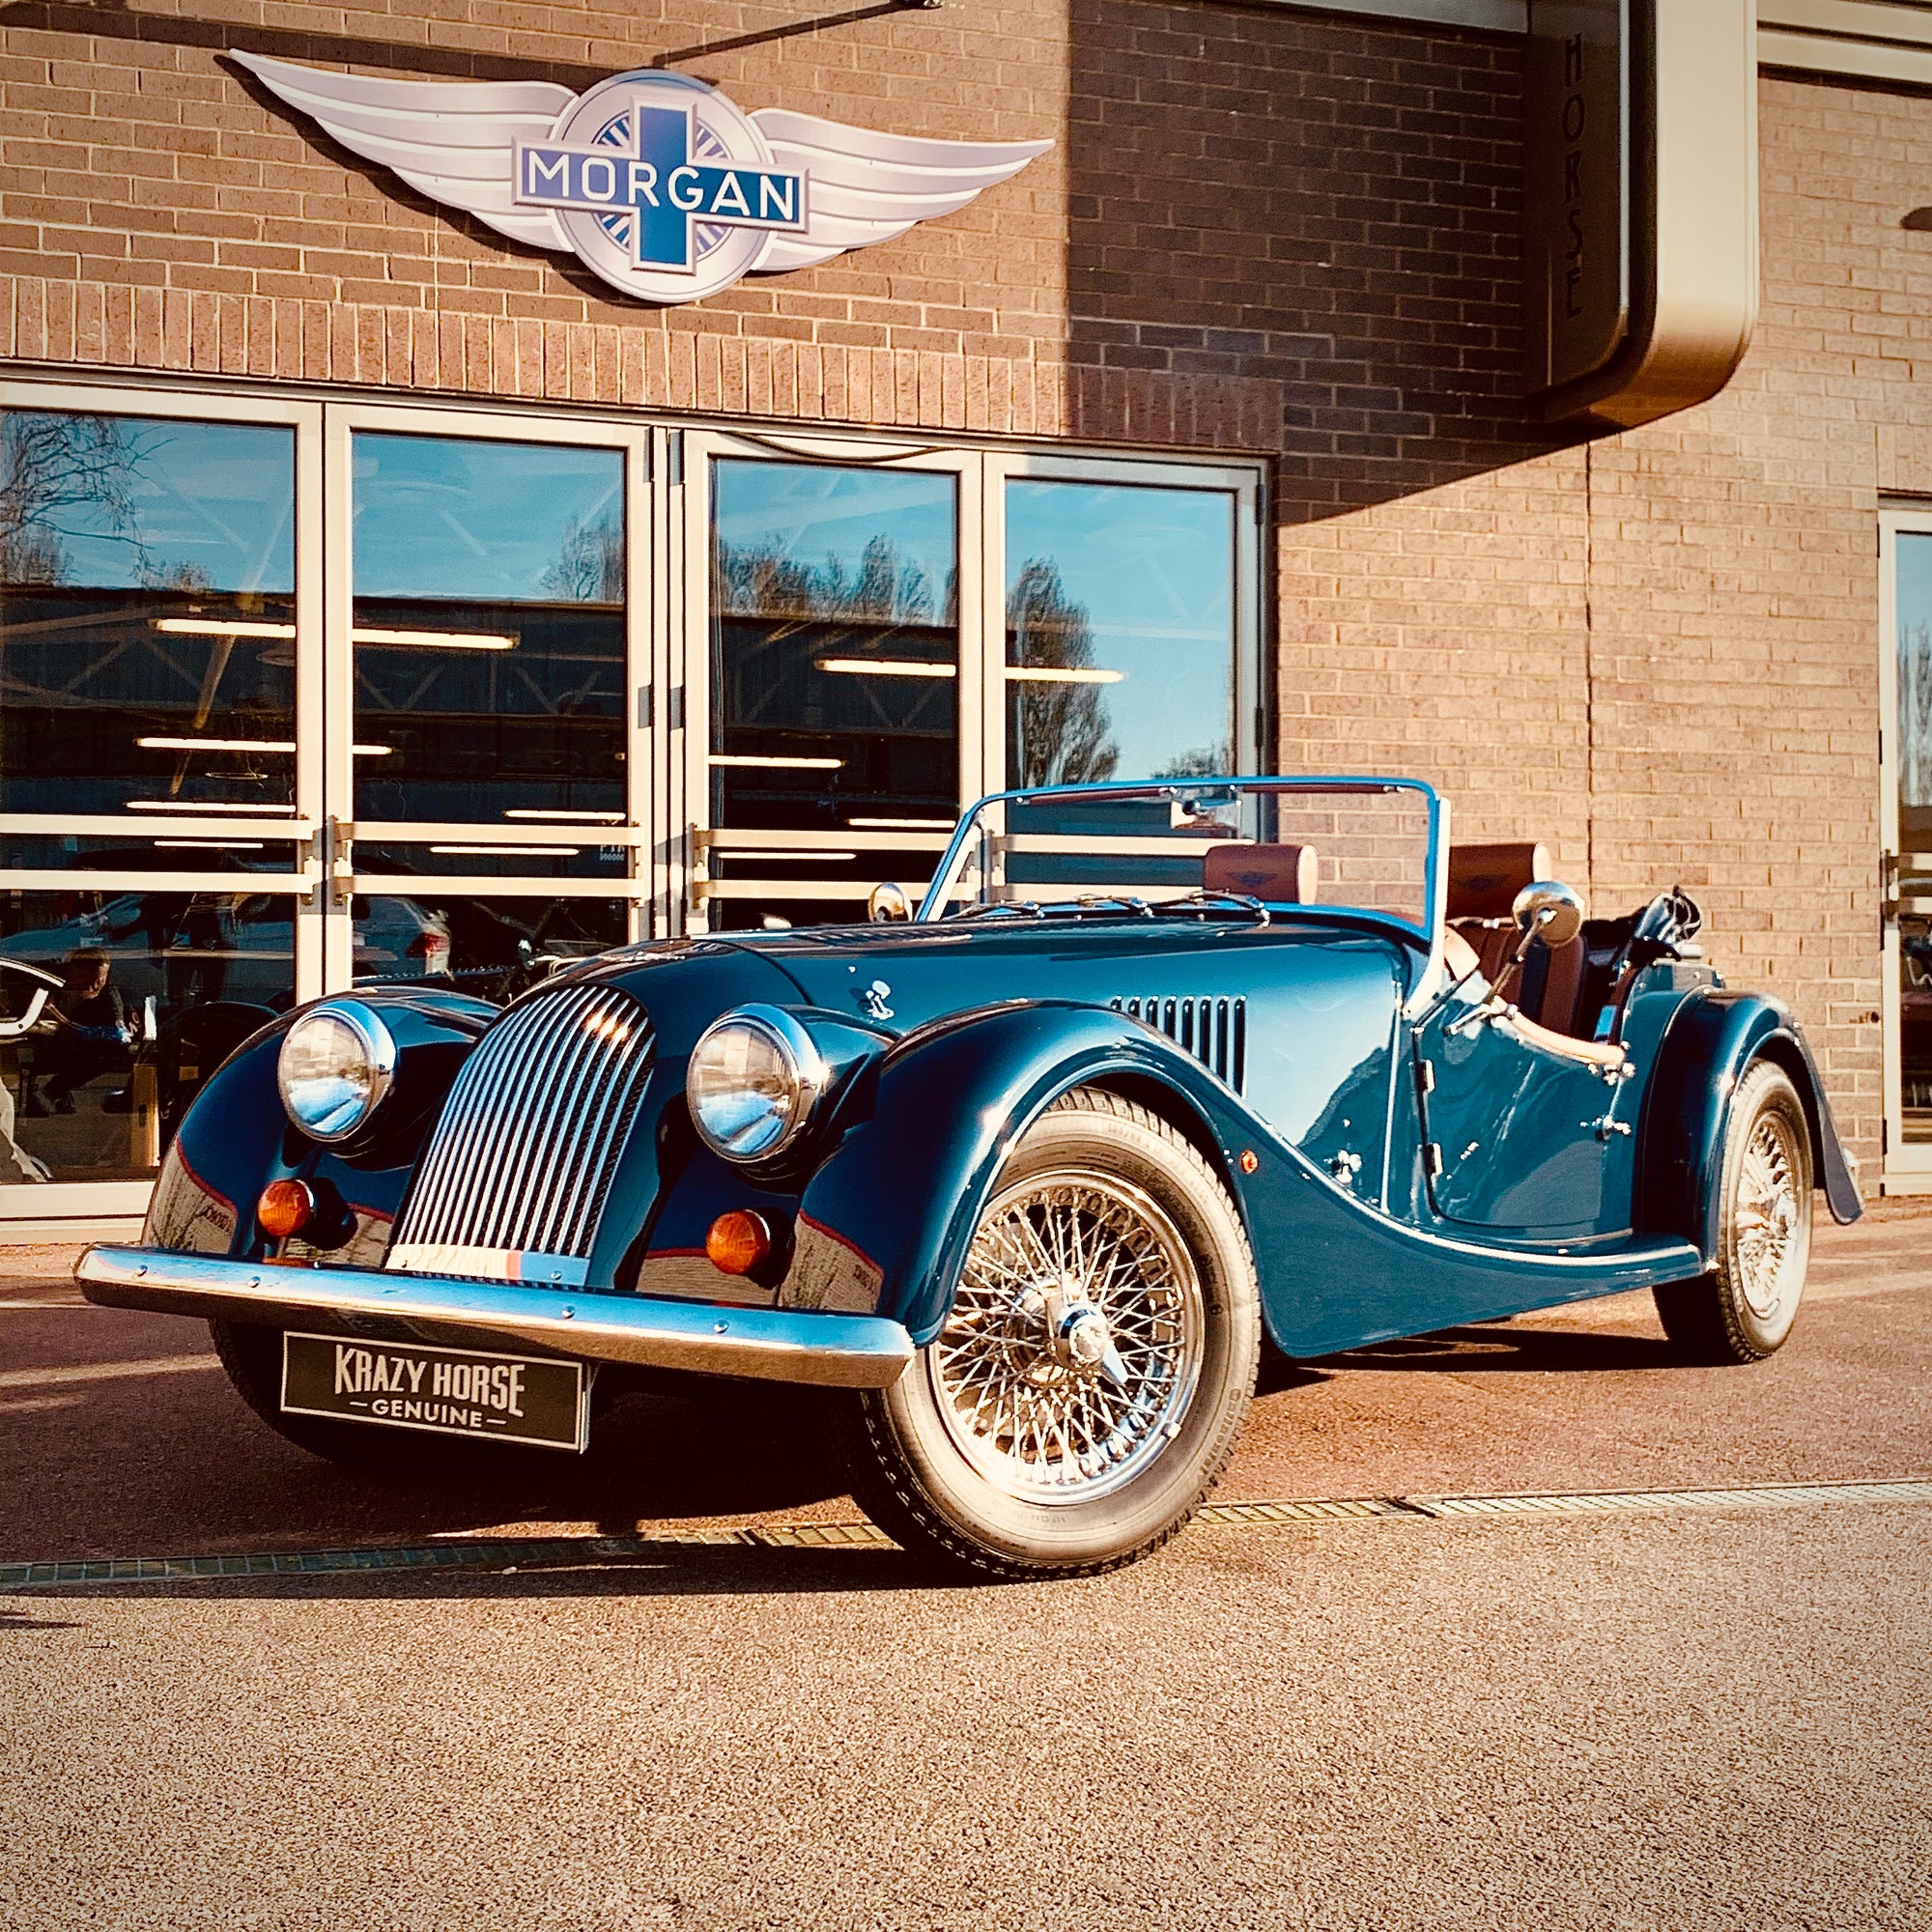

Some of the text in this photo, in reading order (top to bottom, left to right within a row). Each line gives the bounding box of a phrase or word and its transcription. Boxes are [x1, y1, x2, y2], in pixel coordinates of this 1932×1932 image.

[528, 150, 794, 221] MORGAN
[1561, 32, 1586, 320] HORSE
[334, 1344, 526, 1417] KRAZY HORSE
[371, 1399, 483, 1428] GENUINE
